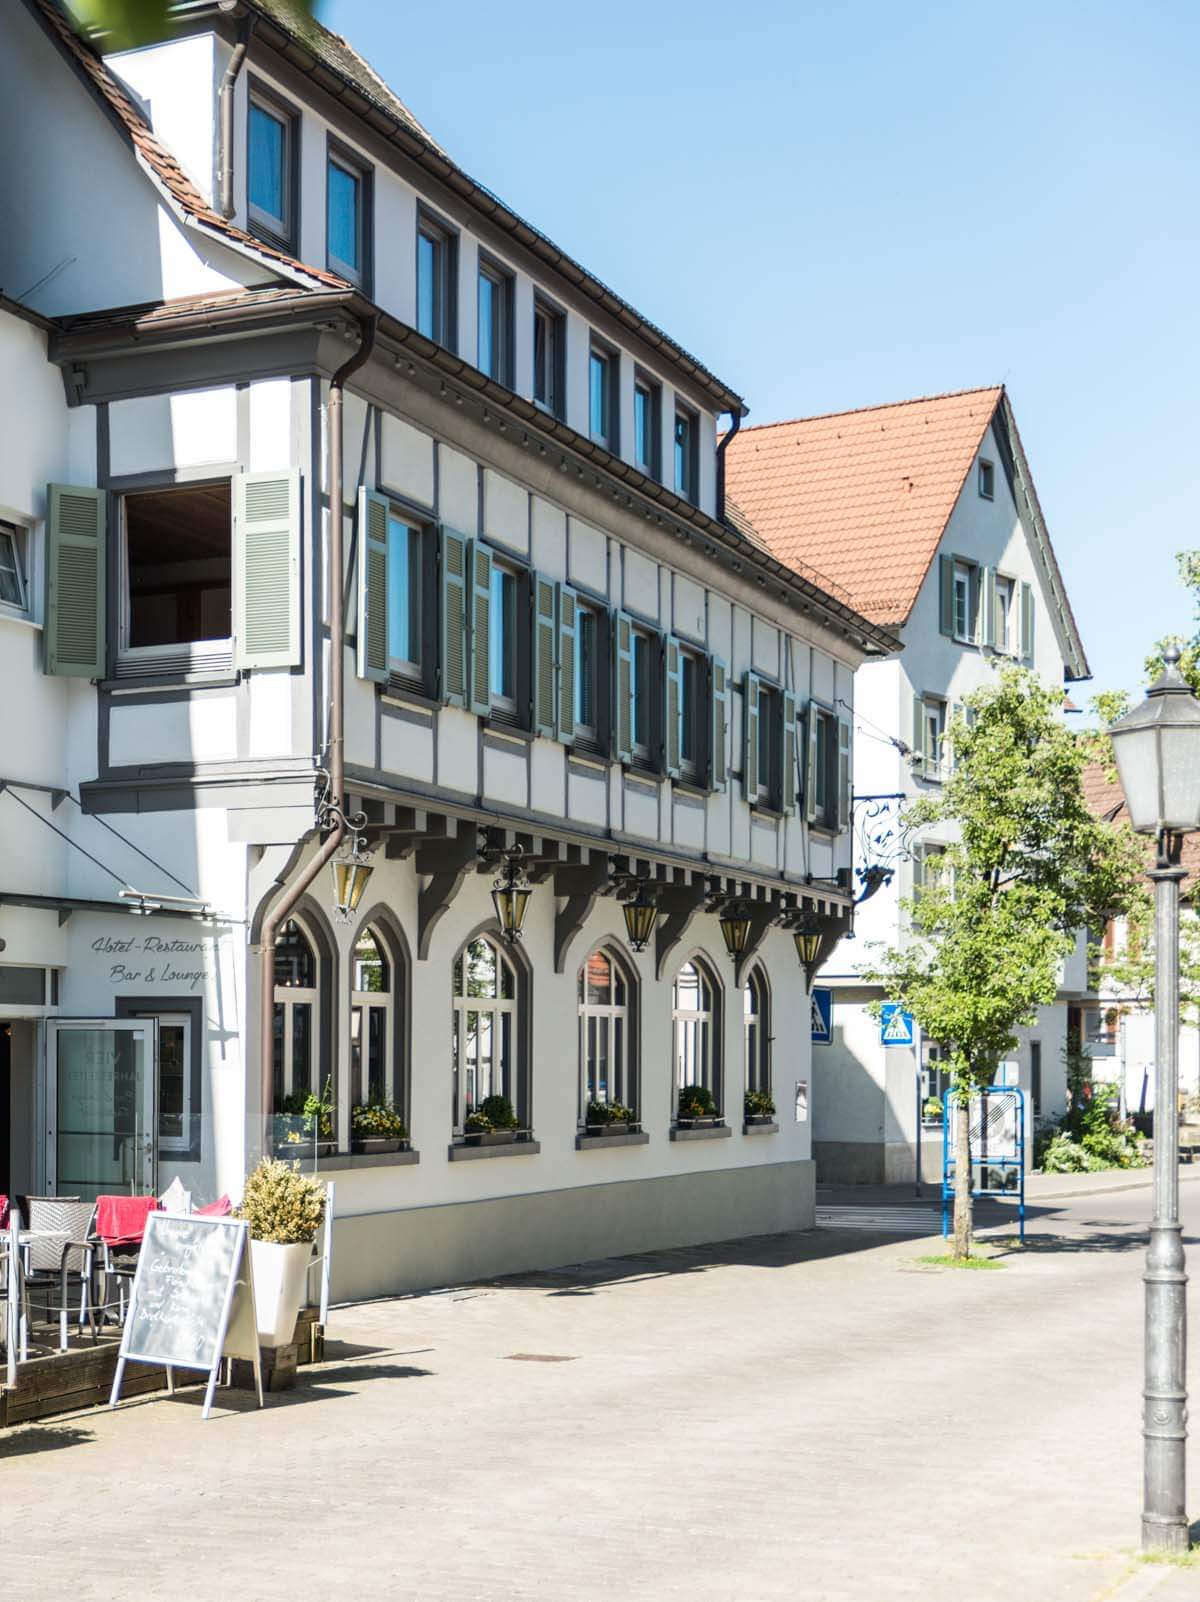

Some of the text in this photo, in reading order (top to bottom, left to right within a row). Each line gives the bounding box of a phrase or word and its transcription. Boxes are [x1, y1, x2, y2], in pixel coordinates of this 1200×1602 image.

[110, 963, 208, 990] Bar & Lounge
